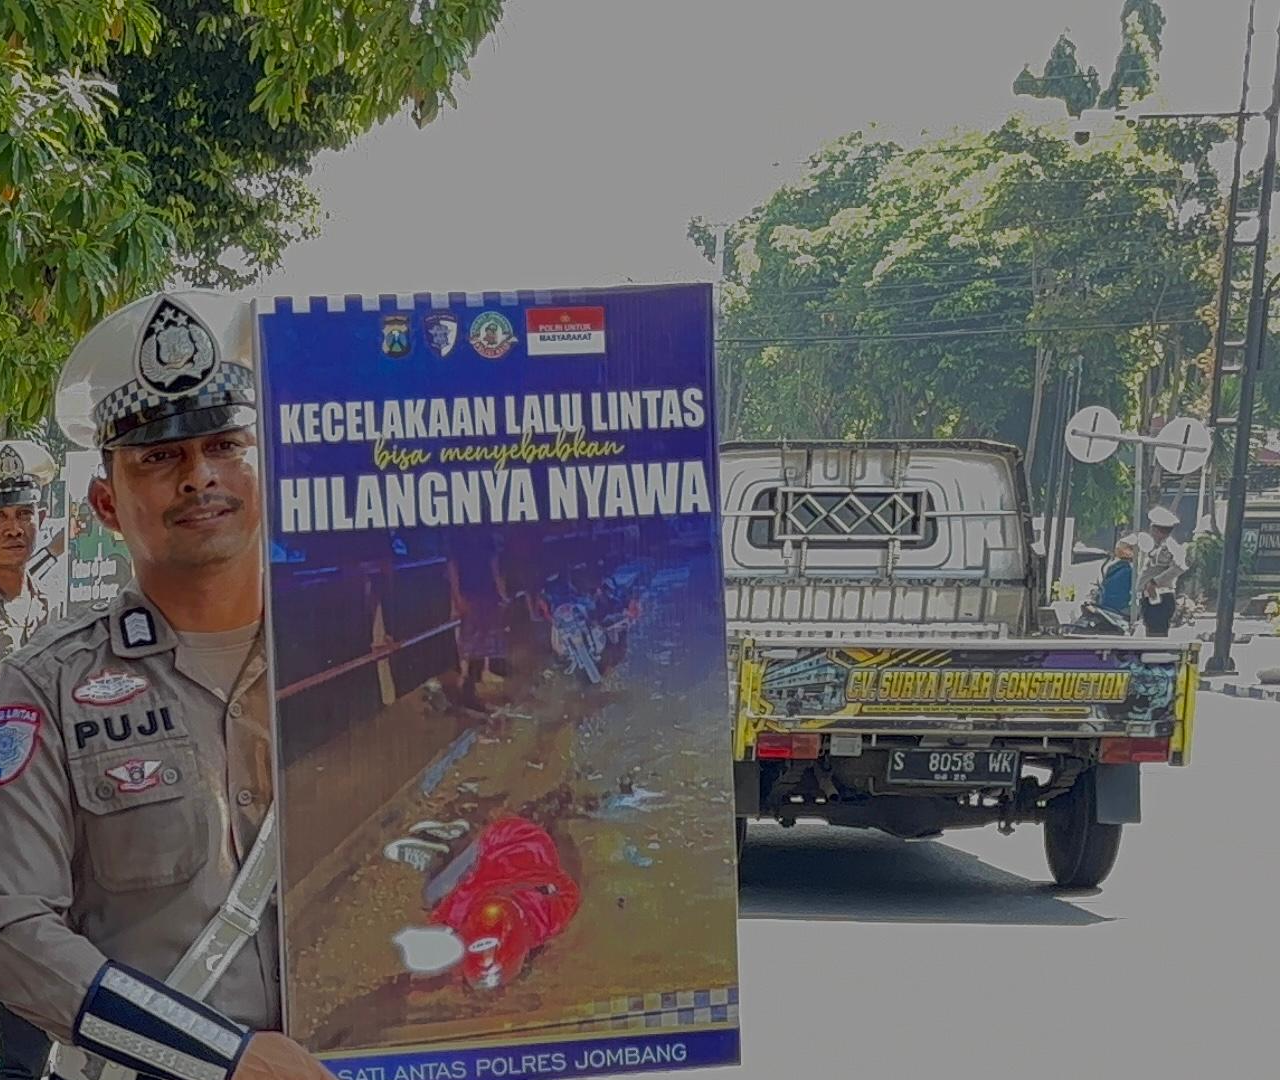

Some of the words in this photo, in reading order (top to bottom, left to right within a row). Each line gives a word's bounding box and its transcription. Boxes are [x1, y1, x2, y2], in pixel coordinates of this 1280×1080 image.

[279, 397, 497, 444] KECELAKAAN
[504, 392, 582, 434] LALU
[592, 387, 706, 432] LINTAS
[373, 436, 432, 472] bisa
[441, 426, 626, 473] menyebabkan
[279, 469, 539, 533] HILANGNYA
[549, 460, 712, 520] NYAWA
[880, 670, 939, 700] SURYA
[942, 670, 993, 700] PILAR
[994, 671, 1130, 702] CONSTRUCTION
[74, 706, 175, 750] PUJI
[894, 752, 905, 771] S
[989, 753, 1013, 773] WK
[475, 1053, 567, 1079] POLRES
[574, 1043, 687, 1070] JOMBANG
